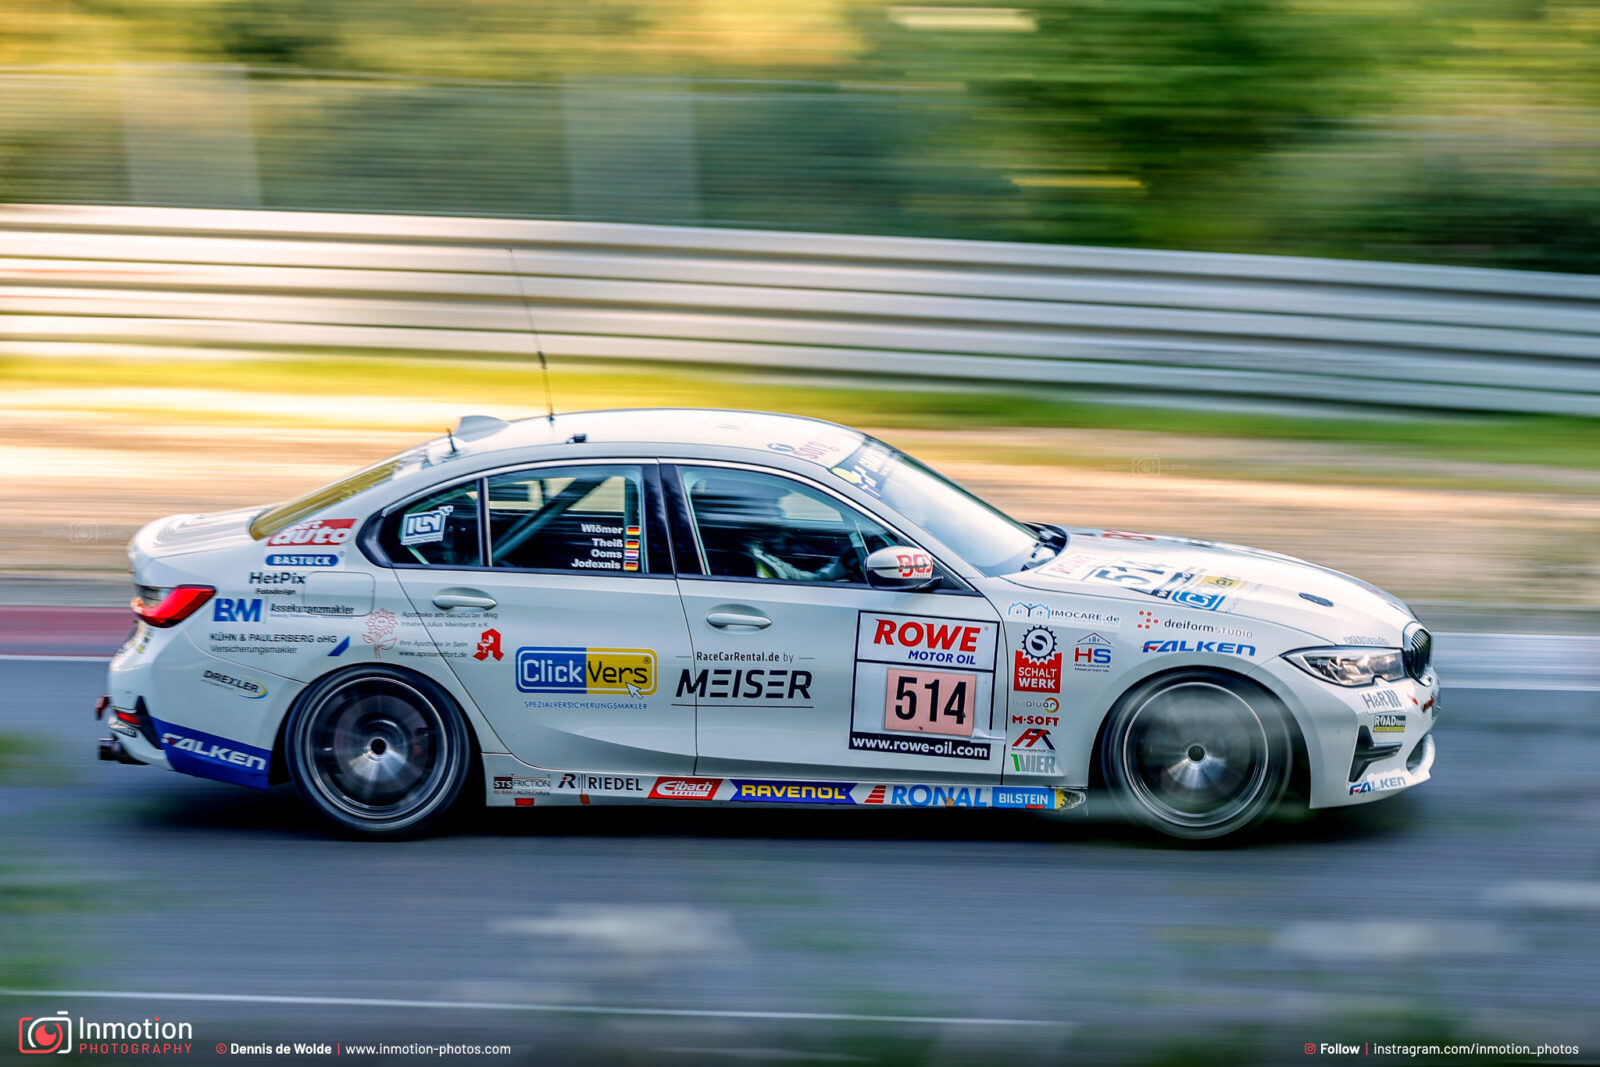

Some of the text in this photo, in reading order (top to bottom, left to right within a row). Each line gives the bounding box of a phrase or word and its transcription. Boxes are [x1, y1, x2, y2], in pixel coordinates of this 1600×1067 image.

[581, 523, 623, 534] Wlömer
[592, 538, 623, 548] Theiß
[591, 549, 622, 558] Ooms
[272, 556, 331, 565] BASTUCK
[249, 572, 306, 584] HetPix
[271, 603, 354, 615] Assekuranzmakler
[209, 631, 338, 643] KÜHN & PAULERBERG oHG
[873, 618, 981, 652] ROWE
[209, 644, 298, 655] Versicherungsmakler
[1142, 640, 1257, 656] FALKEN
[696, 651, 794, 664] RaceCarRental.de by
[908, 650, 976, 665] MOTOR OIL
[1074, 647, 1112, 664] HS
[1018, 666, 1057, 678] SCHALT
[203, 669, 260, 693] DREXLER
[675, 669, 813, 699] MEISER
[1018, 677, 1056, 689] WERK
[524, 701, 648, 710] SPEZIALVERSICHERUNGSMAKLER
[895, 675, 967, 725] 514
[161, 733, 267, 770] FALKEN
[852, 736, 988, 757] www.rowe-oil.com
[494, 779, 551, 788] STS FRICTION
[588, 777, 643, 791] RIEDEL
[656, 780, 714, 796] Eibach
[1349, 776, 1407, 796] FALKEN
[891, 784, 988, 807] RONAL
[998, 792, 1050, 805] BILSTEIN
